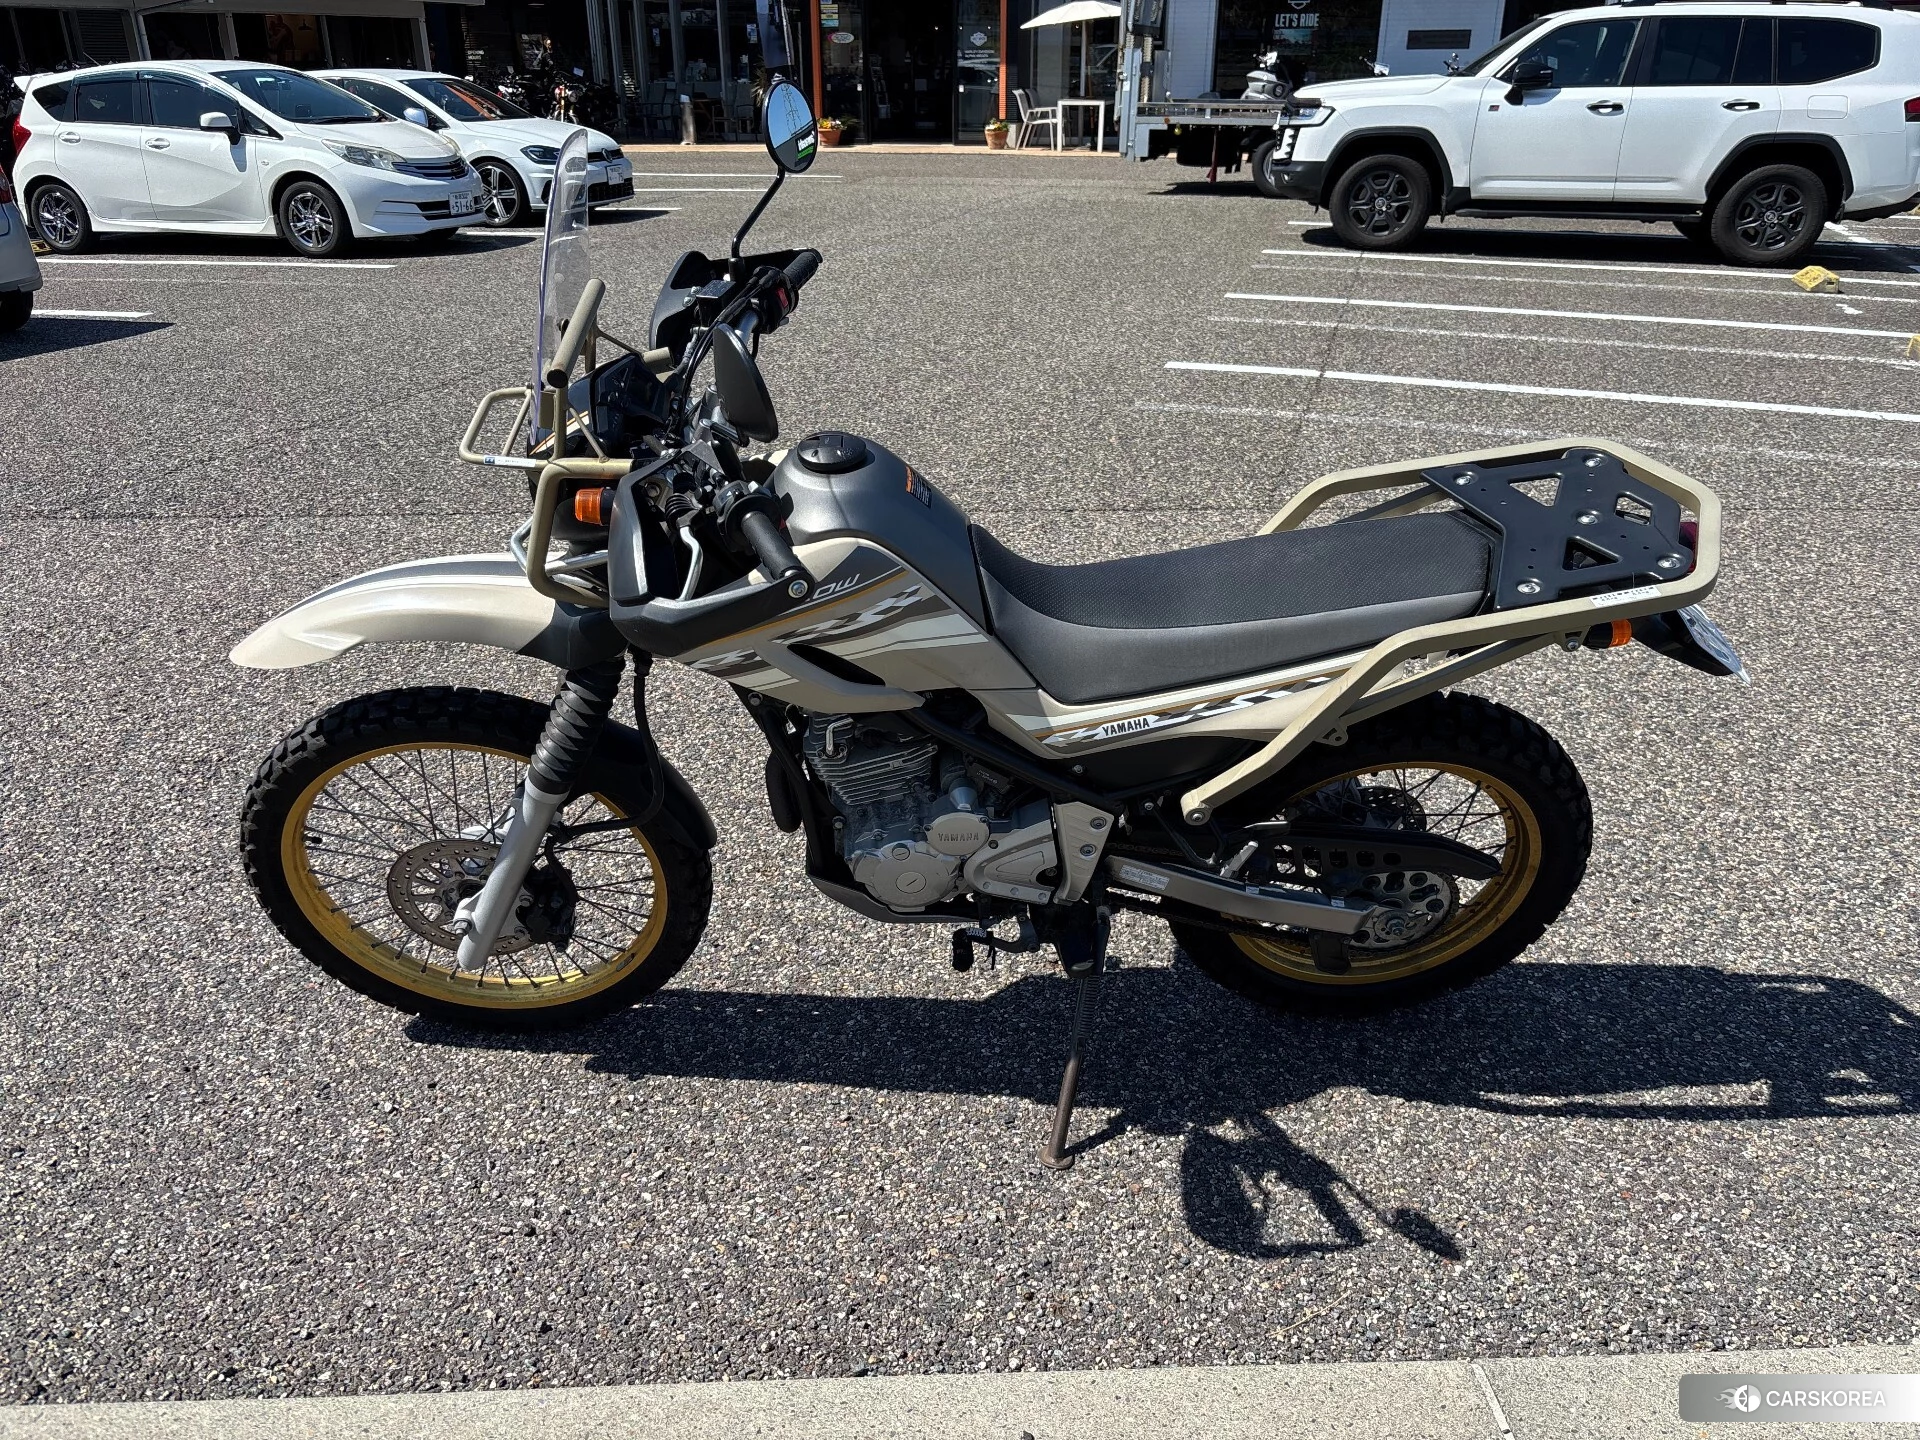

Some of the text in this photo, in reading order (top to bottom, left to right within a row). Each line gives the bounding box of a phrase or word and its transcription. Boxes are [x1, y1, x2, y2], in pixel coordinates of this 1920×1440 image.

[1275, 13, 1320, 27] LET'S RIDE
[1101, 717, 1151, 737] YAMAHA
[937, 831, 980, 842] YAMAHA
